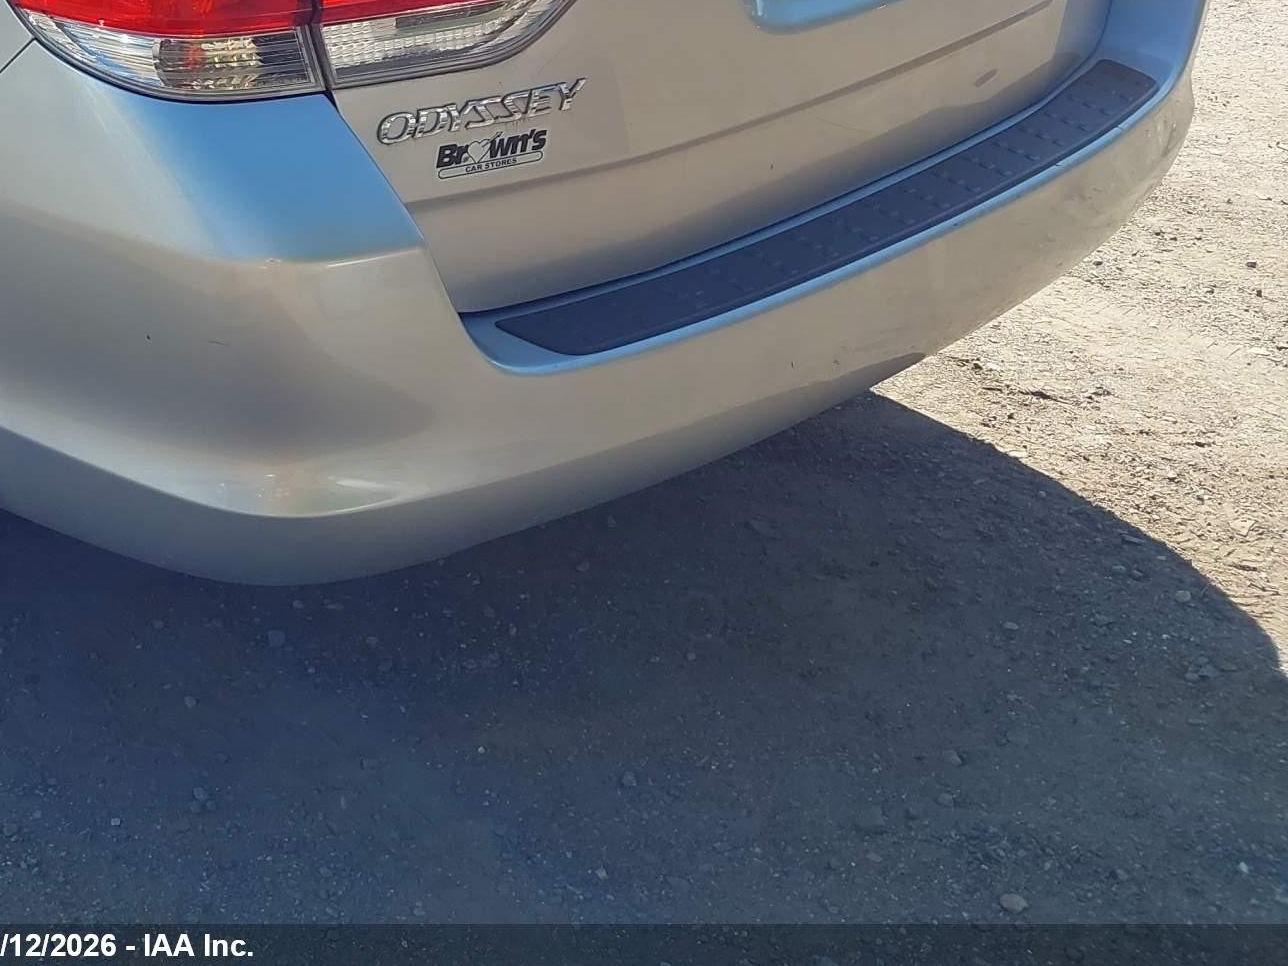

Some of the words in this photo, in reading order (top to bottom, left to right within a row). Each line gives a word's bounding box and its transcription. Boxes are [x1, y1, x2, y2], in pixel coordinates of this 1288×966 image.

[376, 77, 589, 146] ODYSSEY
[465, 164, 483, 174] CAR
[486, 158, 518, 170] STORES
